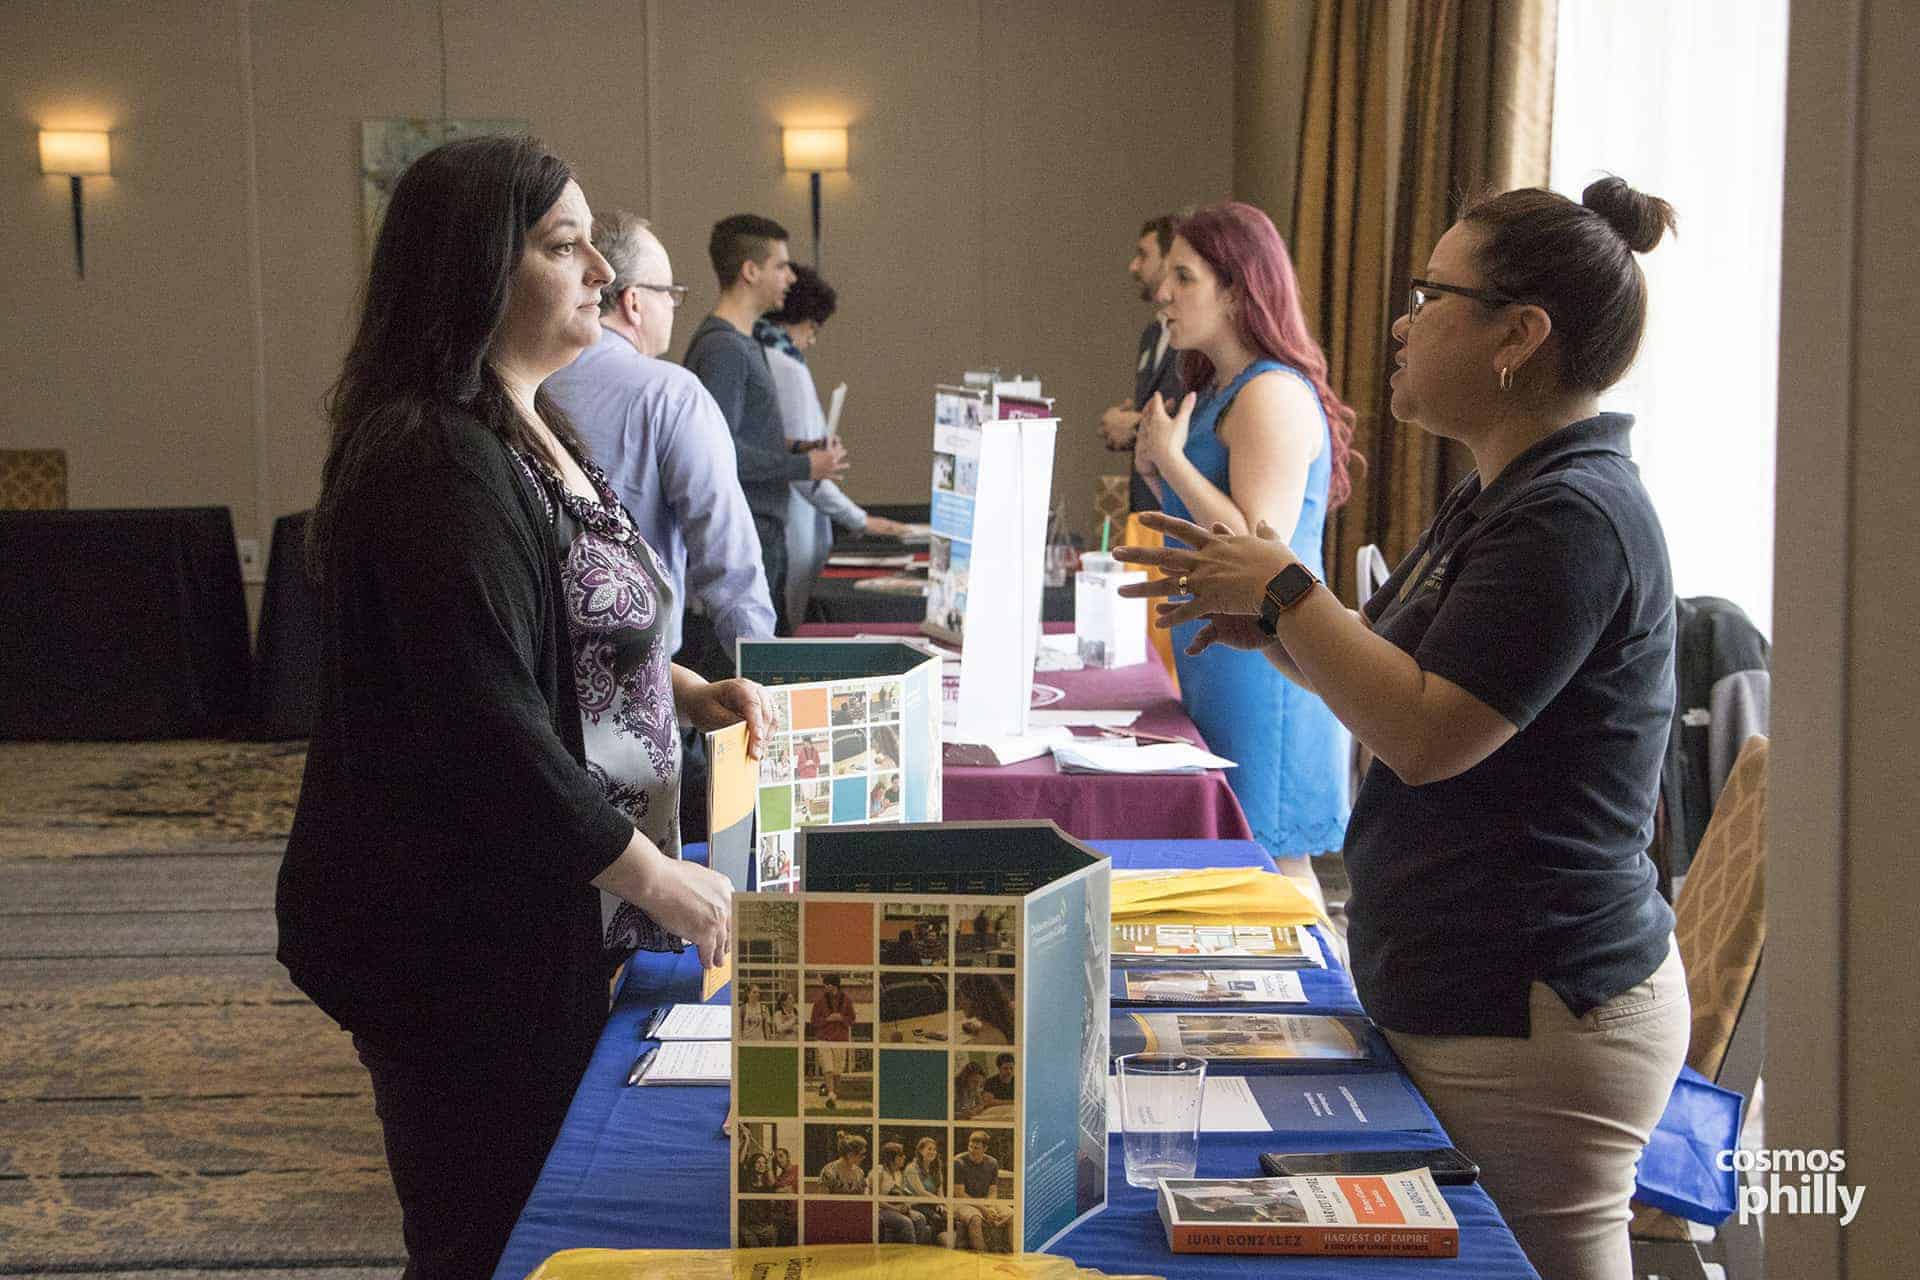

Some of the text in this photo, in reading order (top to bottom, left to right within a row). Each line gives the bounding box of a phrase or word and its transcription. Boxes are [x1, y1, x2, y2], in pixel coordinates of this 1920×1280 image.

[1187, 1233, 1221, 1246] JUAN
[1324, 1232, 1430, 1243] HARVEST OF EMPIRE
